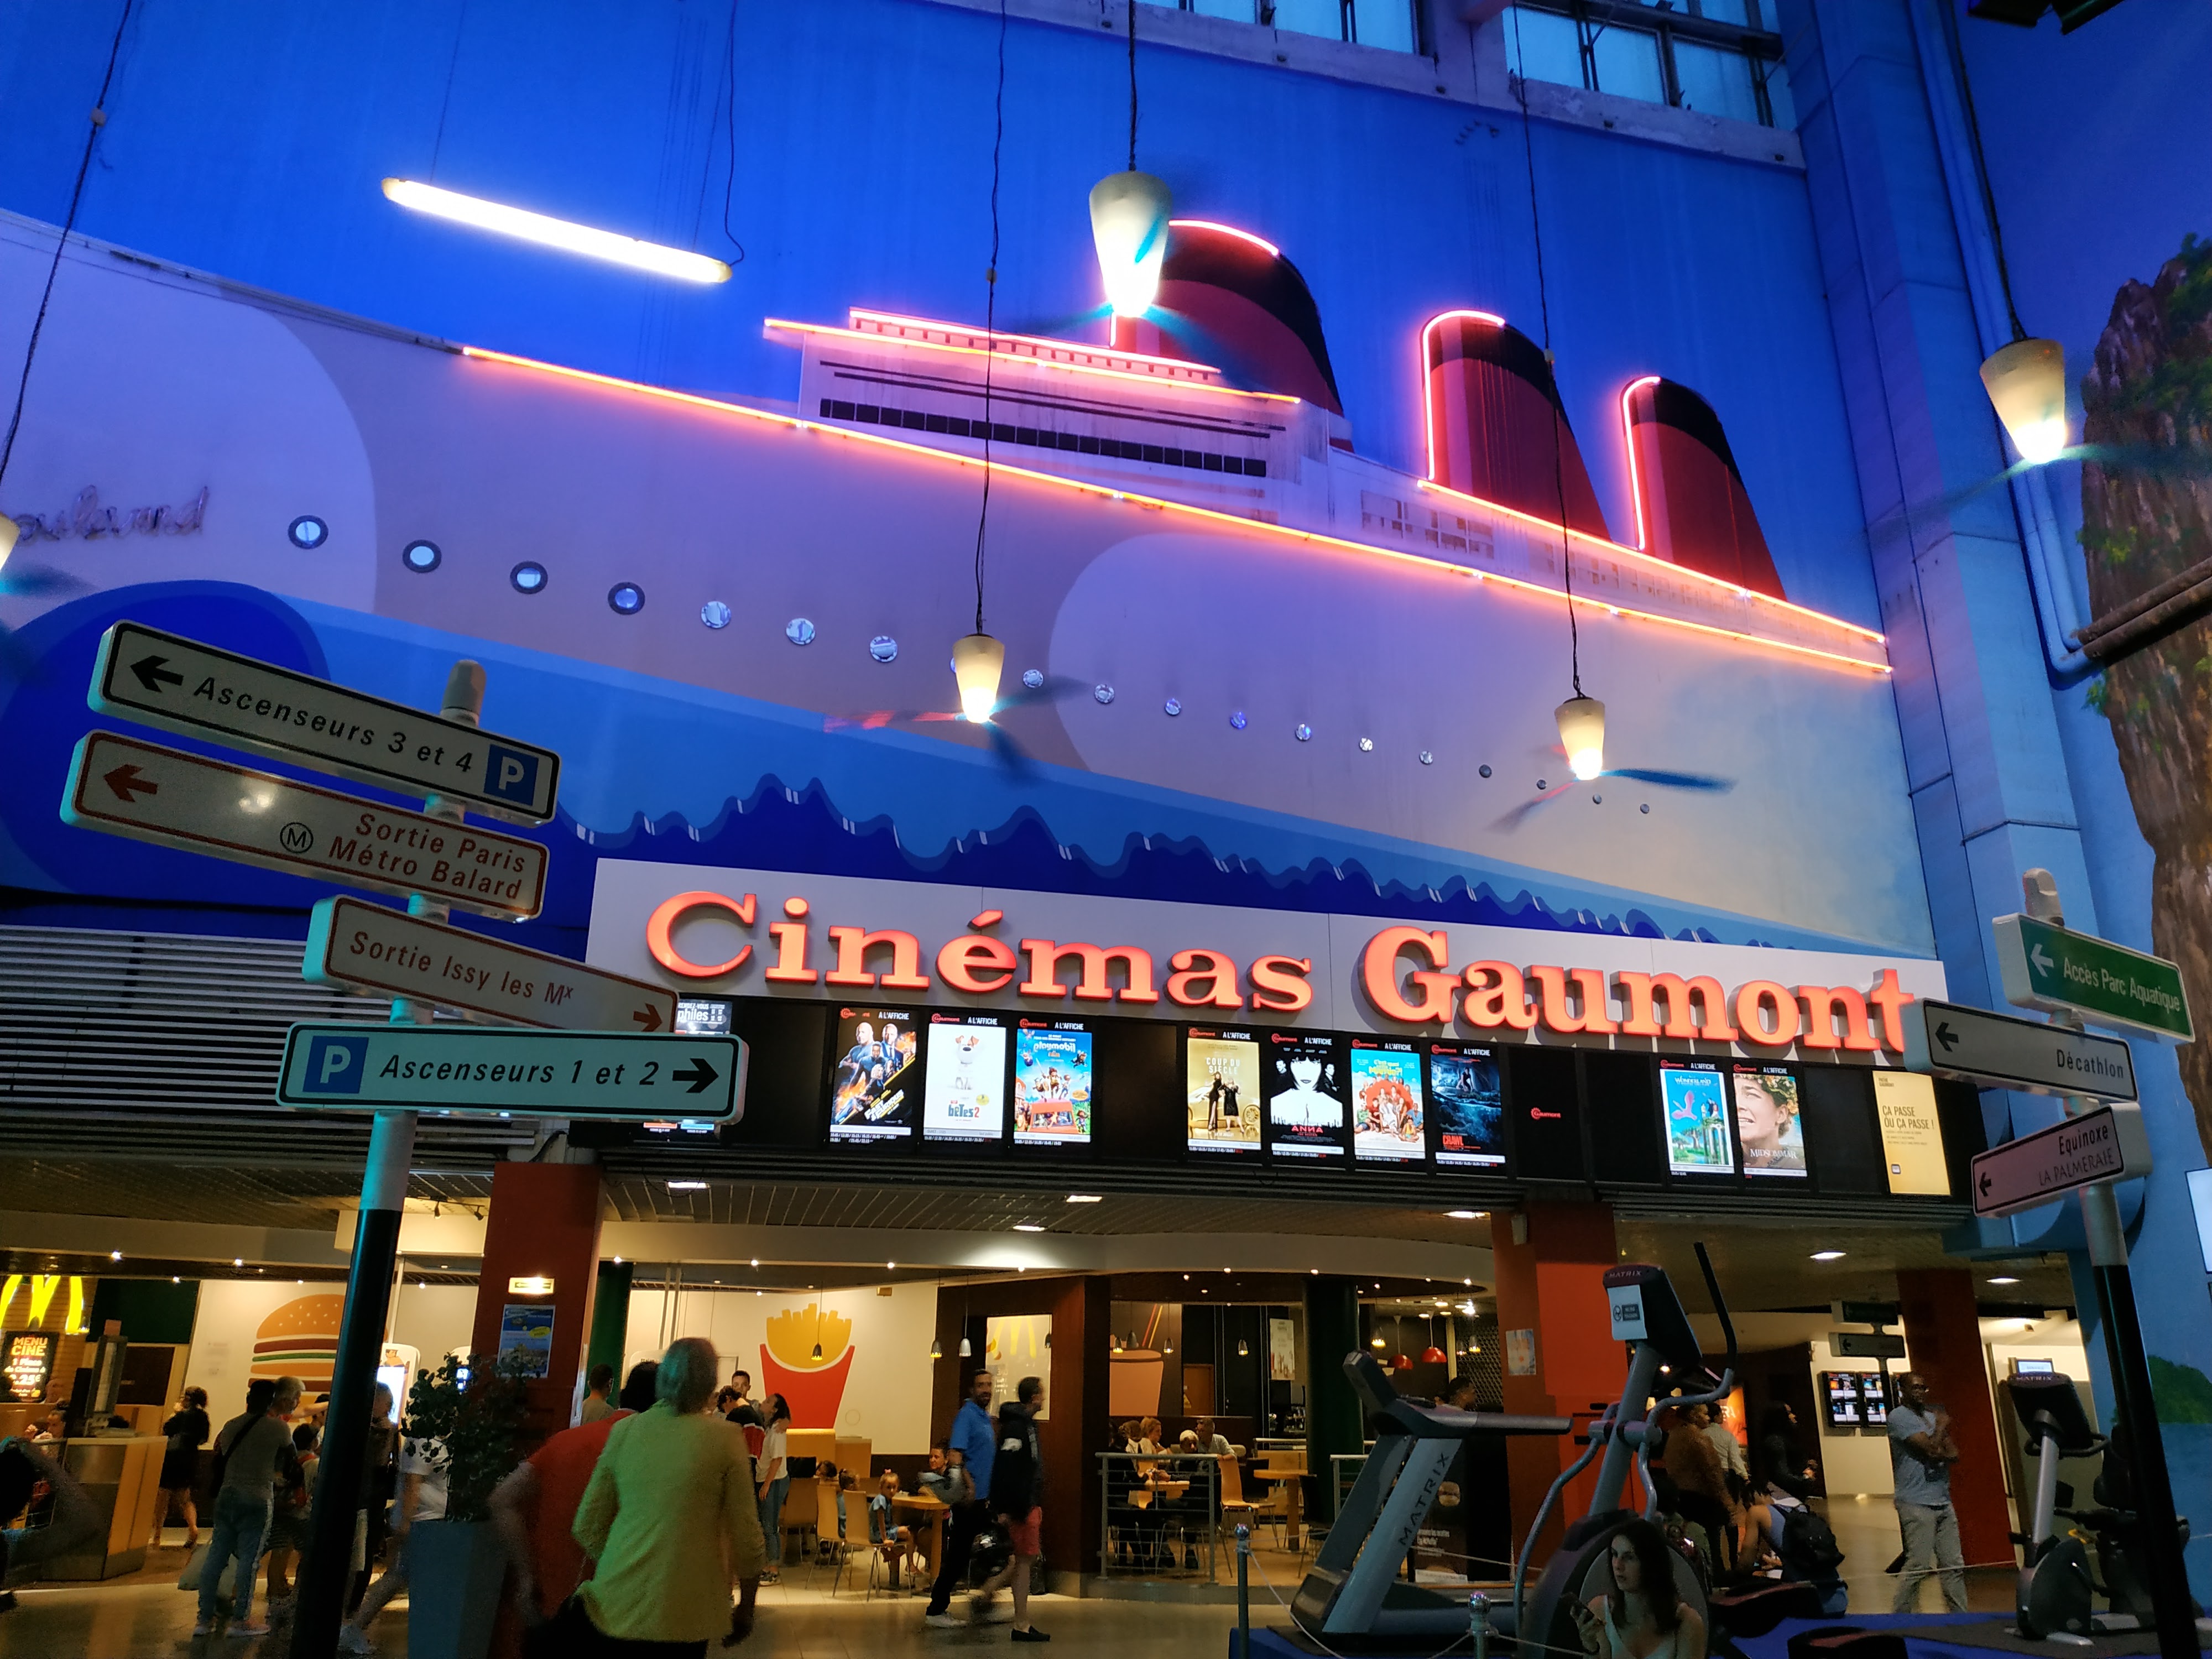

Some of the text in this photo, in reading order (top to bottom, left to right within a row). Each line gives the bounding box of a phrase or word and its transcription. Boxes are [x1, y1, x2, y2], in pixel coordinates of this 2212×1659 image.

[194, 676, 374, 747] Ascenseurs
[388, 732, 405, 754] 3
[418, 744, 442, 766] et
[455, 752, 473, 773] 4
[356, 813, 525, 873] Sortie Paris
[328, 836, 522, 900] Métro Balard
[350, 931, 431, 971] Sortie
[443, 956, 491, 990] Issy
[501, 971, 534, 998] les
[645, 890, 1913, 1053] Cinémas Gaumont
[2063, 957, 2180, 1013] Accès Parc Aquatique
[380, 1055, 554, 1083] Ascenseurs
[570, 1060, 582, 1083] 1
[596, 1062, 624, 1085] et
[639, 1062, 659, 1085] 2
[2057, 1050, 2124, 1078] Décathlon
[1882, 1105, 1915, 1117] ÇA PASSE
[1884, 1118, 1894, 1128] OU
[1897, 1118, 1906, 1130] ÇA
[1908, 1119, 1929, 1129] PASSE
[2059, 1123, 2109, 1156] Equinoxe
[2039, 1148, 2113, 1186] LA PALMERAIE
[14, 1337, 48, 1345] MENU
[1398, 1453, 1449, 1546] MATRIX
